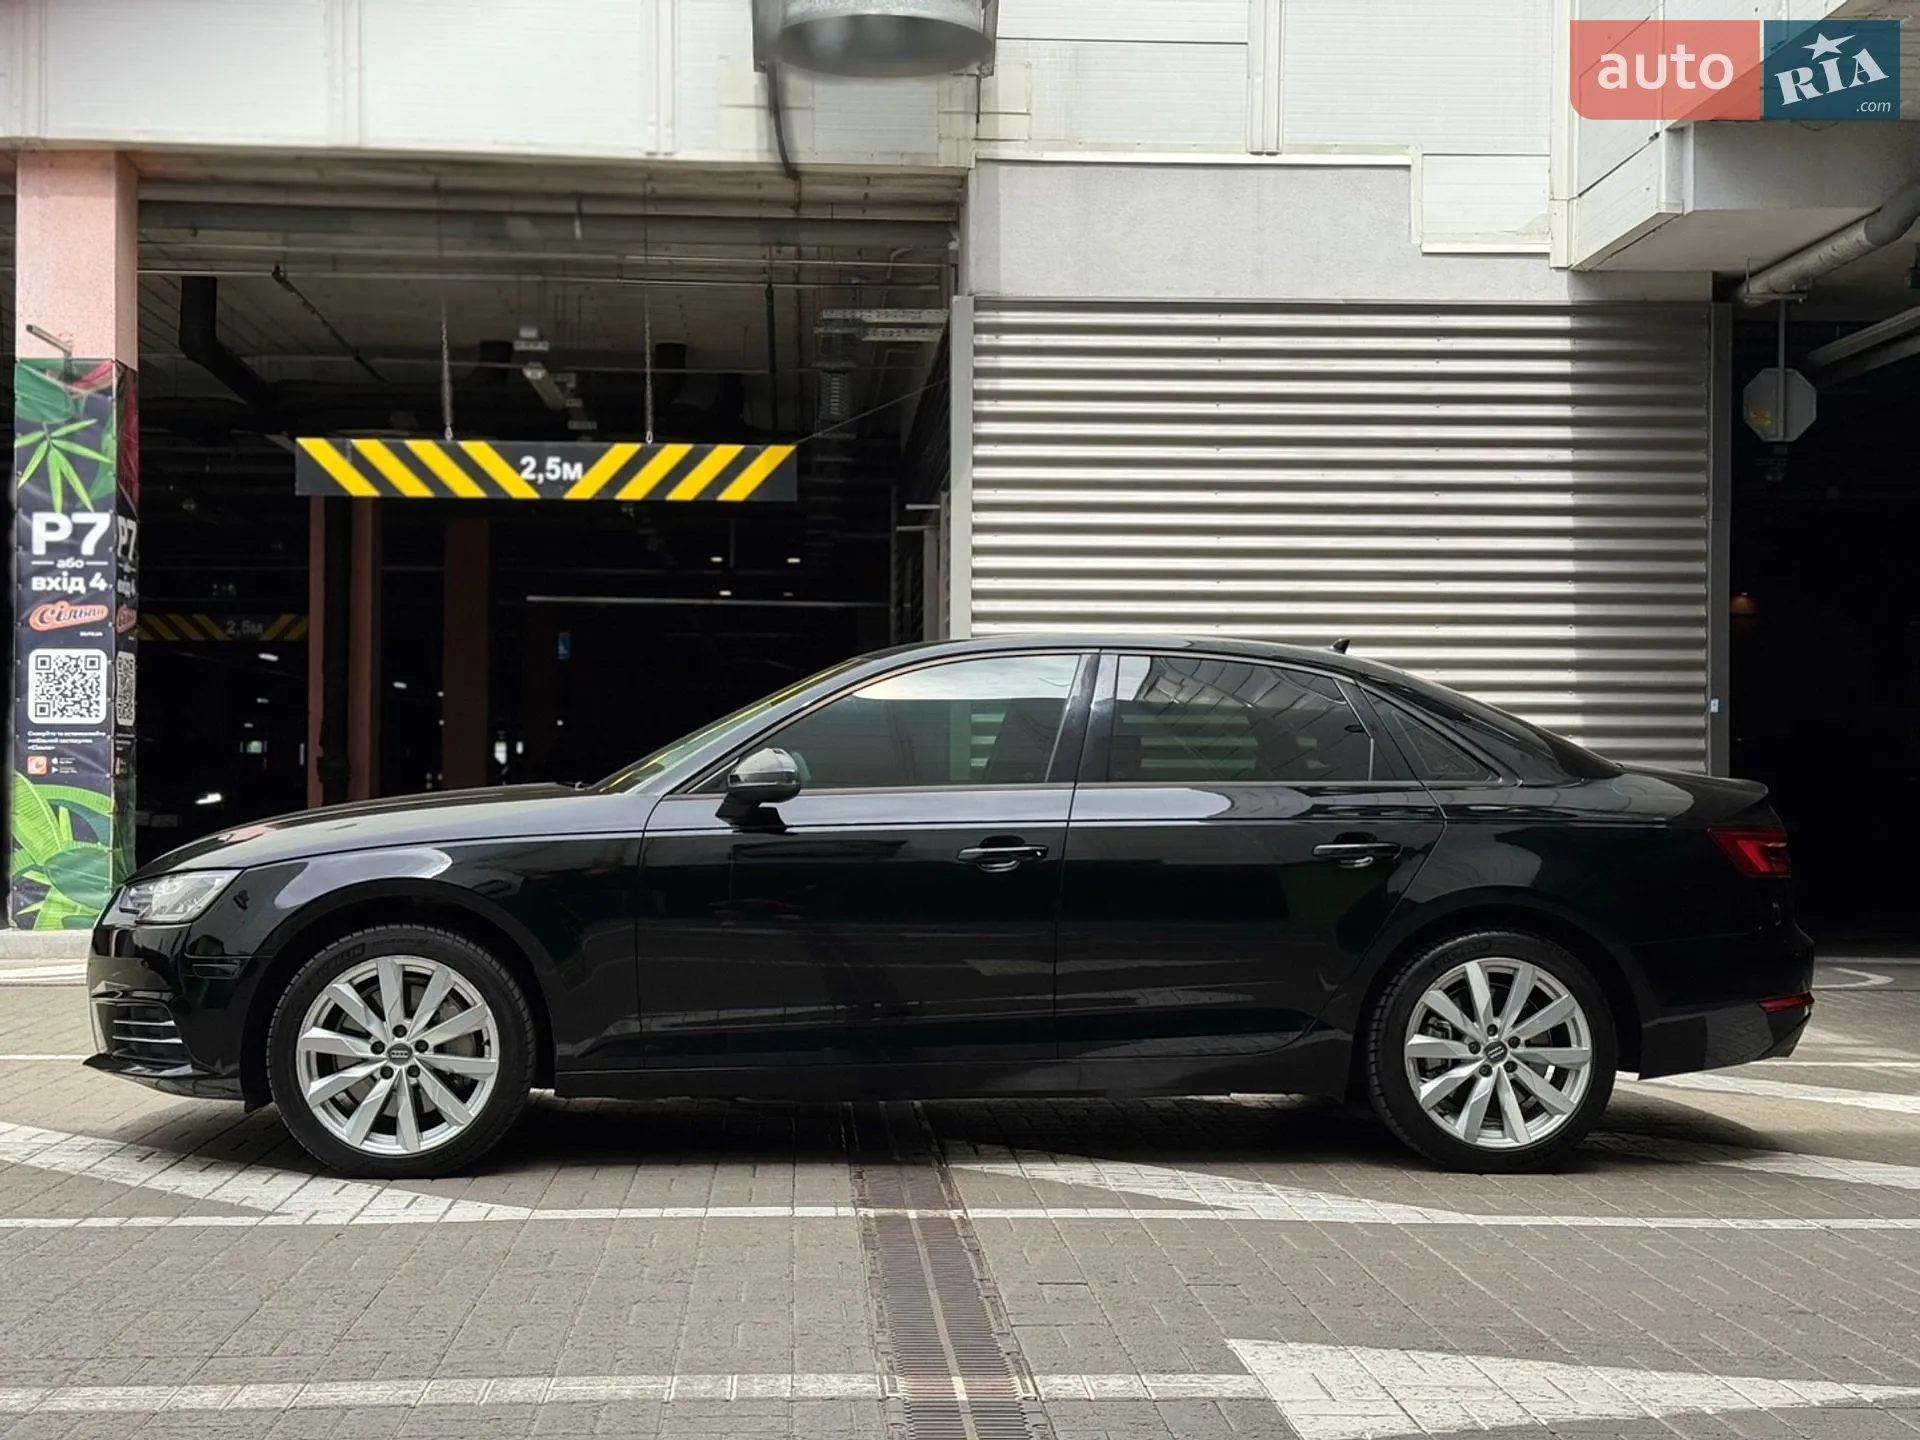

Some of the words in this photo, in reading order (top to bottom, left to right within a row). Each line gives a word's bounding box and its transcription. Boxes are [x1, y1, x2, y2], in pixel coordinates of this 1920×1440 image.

[520, 455, 583, 484] 2,5м
[32, 512, 111, 556] P7
[56, 557, 84, 569] або
[31, 571, 86, 594] вхід
[89, 572, 108, 591] 4
